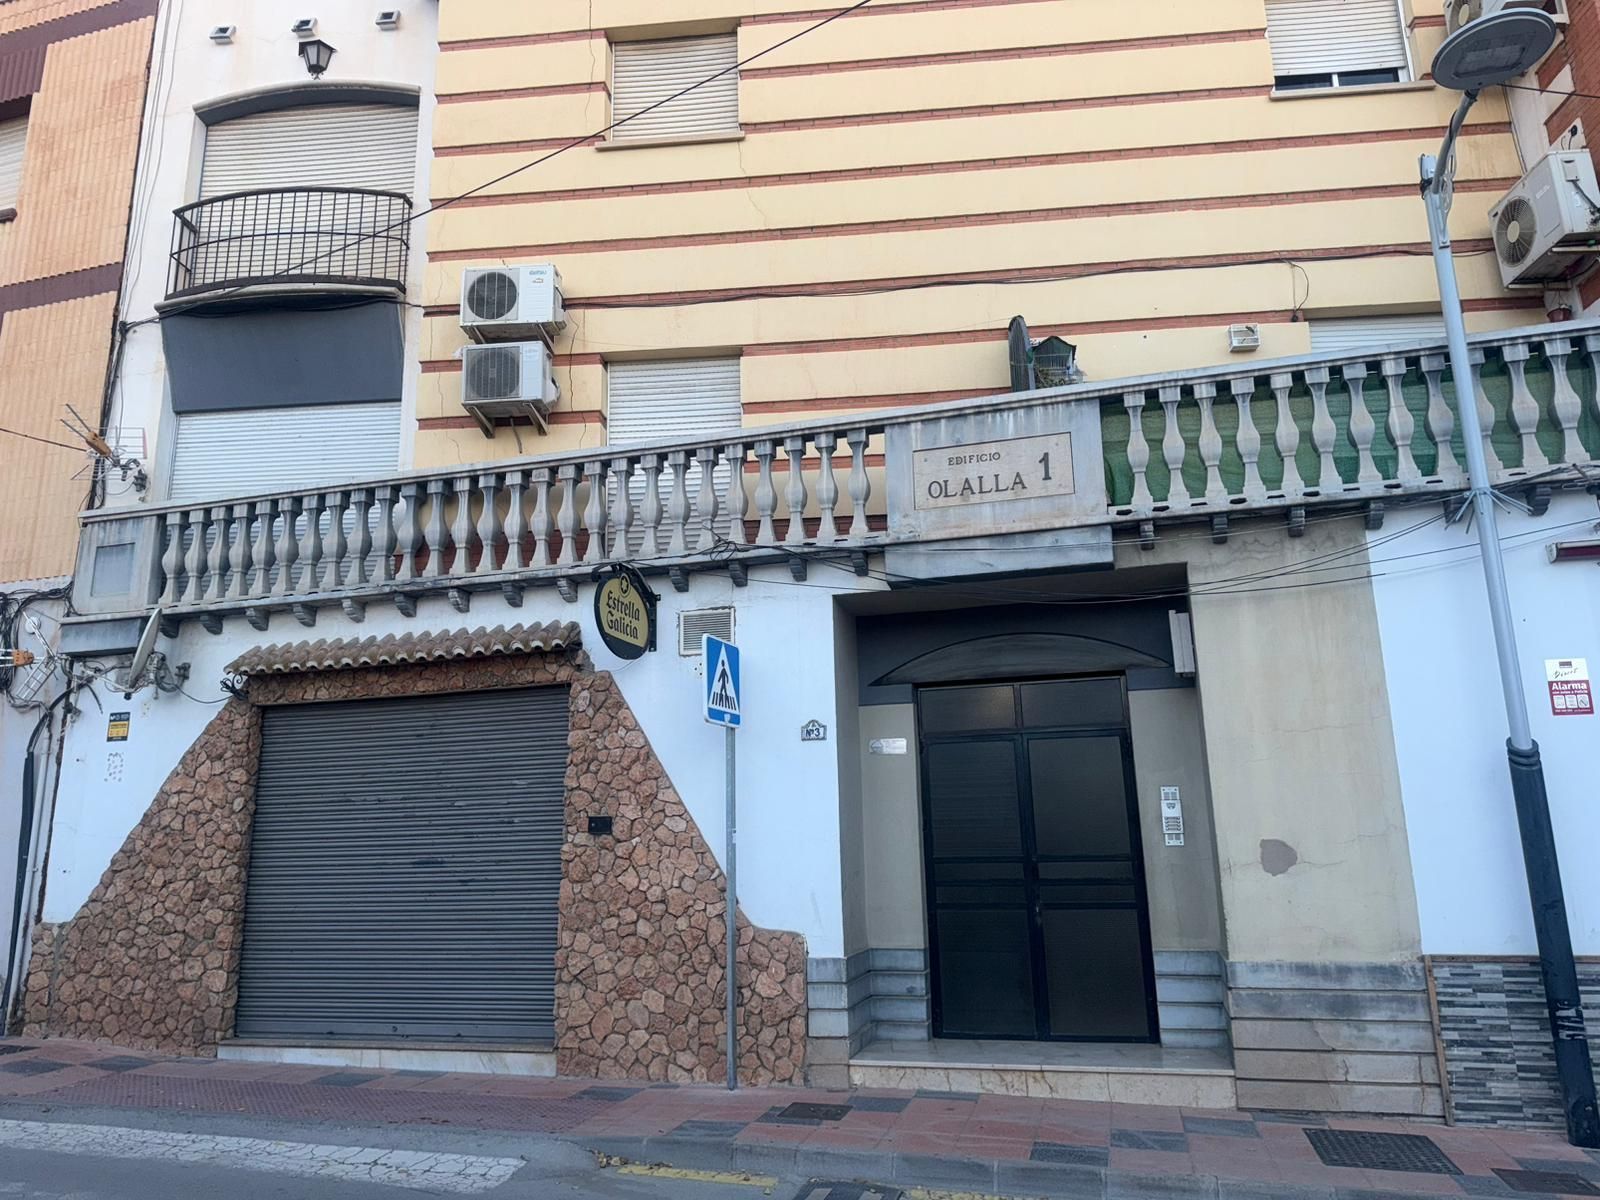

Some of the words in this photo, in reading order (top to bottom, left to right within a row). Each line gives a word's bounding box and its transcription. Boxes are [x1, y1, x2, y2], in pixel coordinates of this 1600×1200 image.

[948, 452, 1001, 466] EDIFICIO
[928, 471, 1027, 499] OLALLA
[1038, 451, 1052, 481] 1
[606, 589, 640, 622] Estrella
[606, 610, 639, 640] Galicia
[1551, 681, 1588, 691] Alarma
